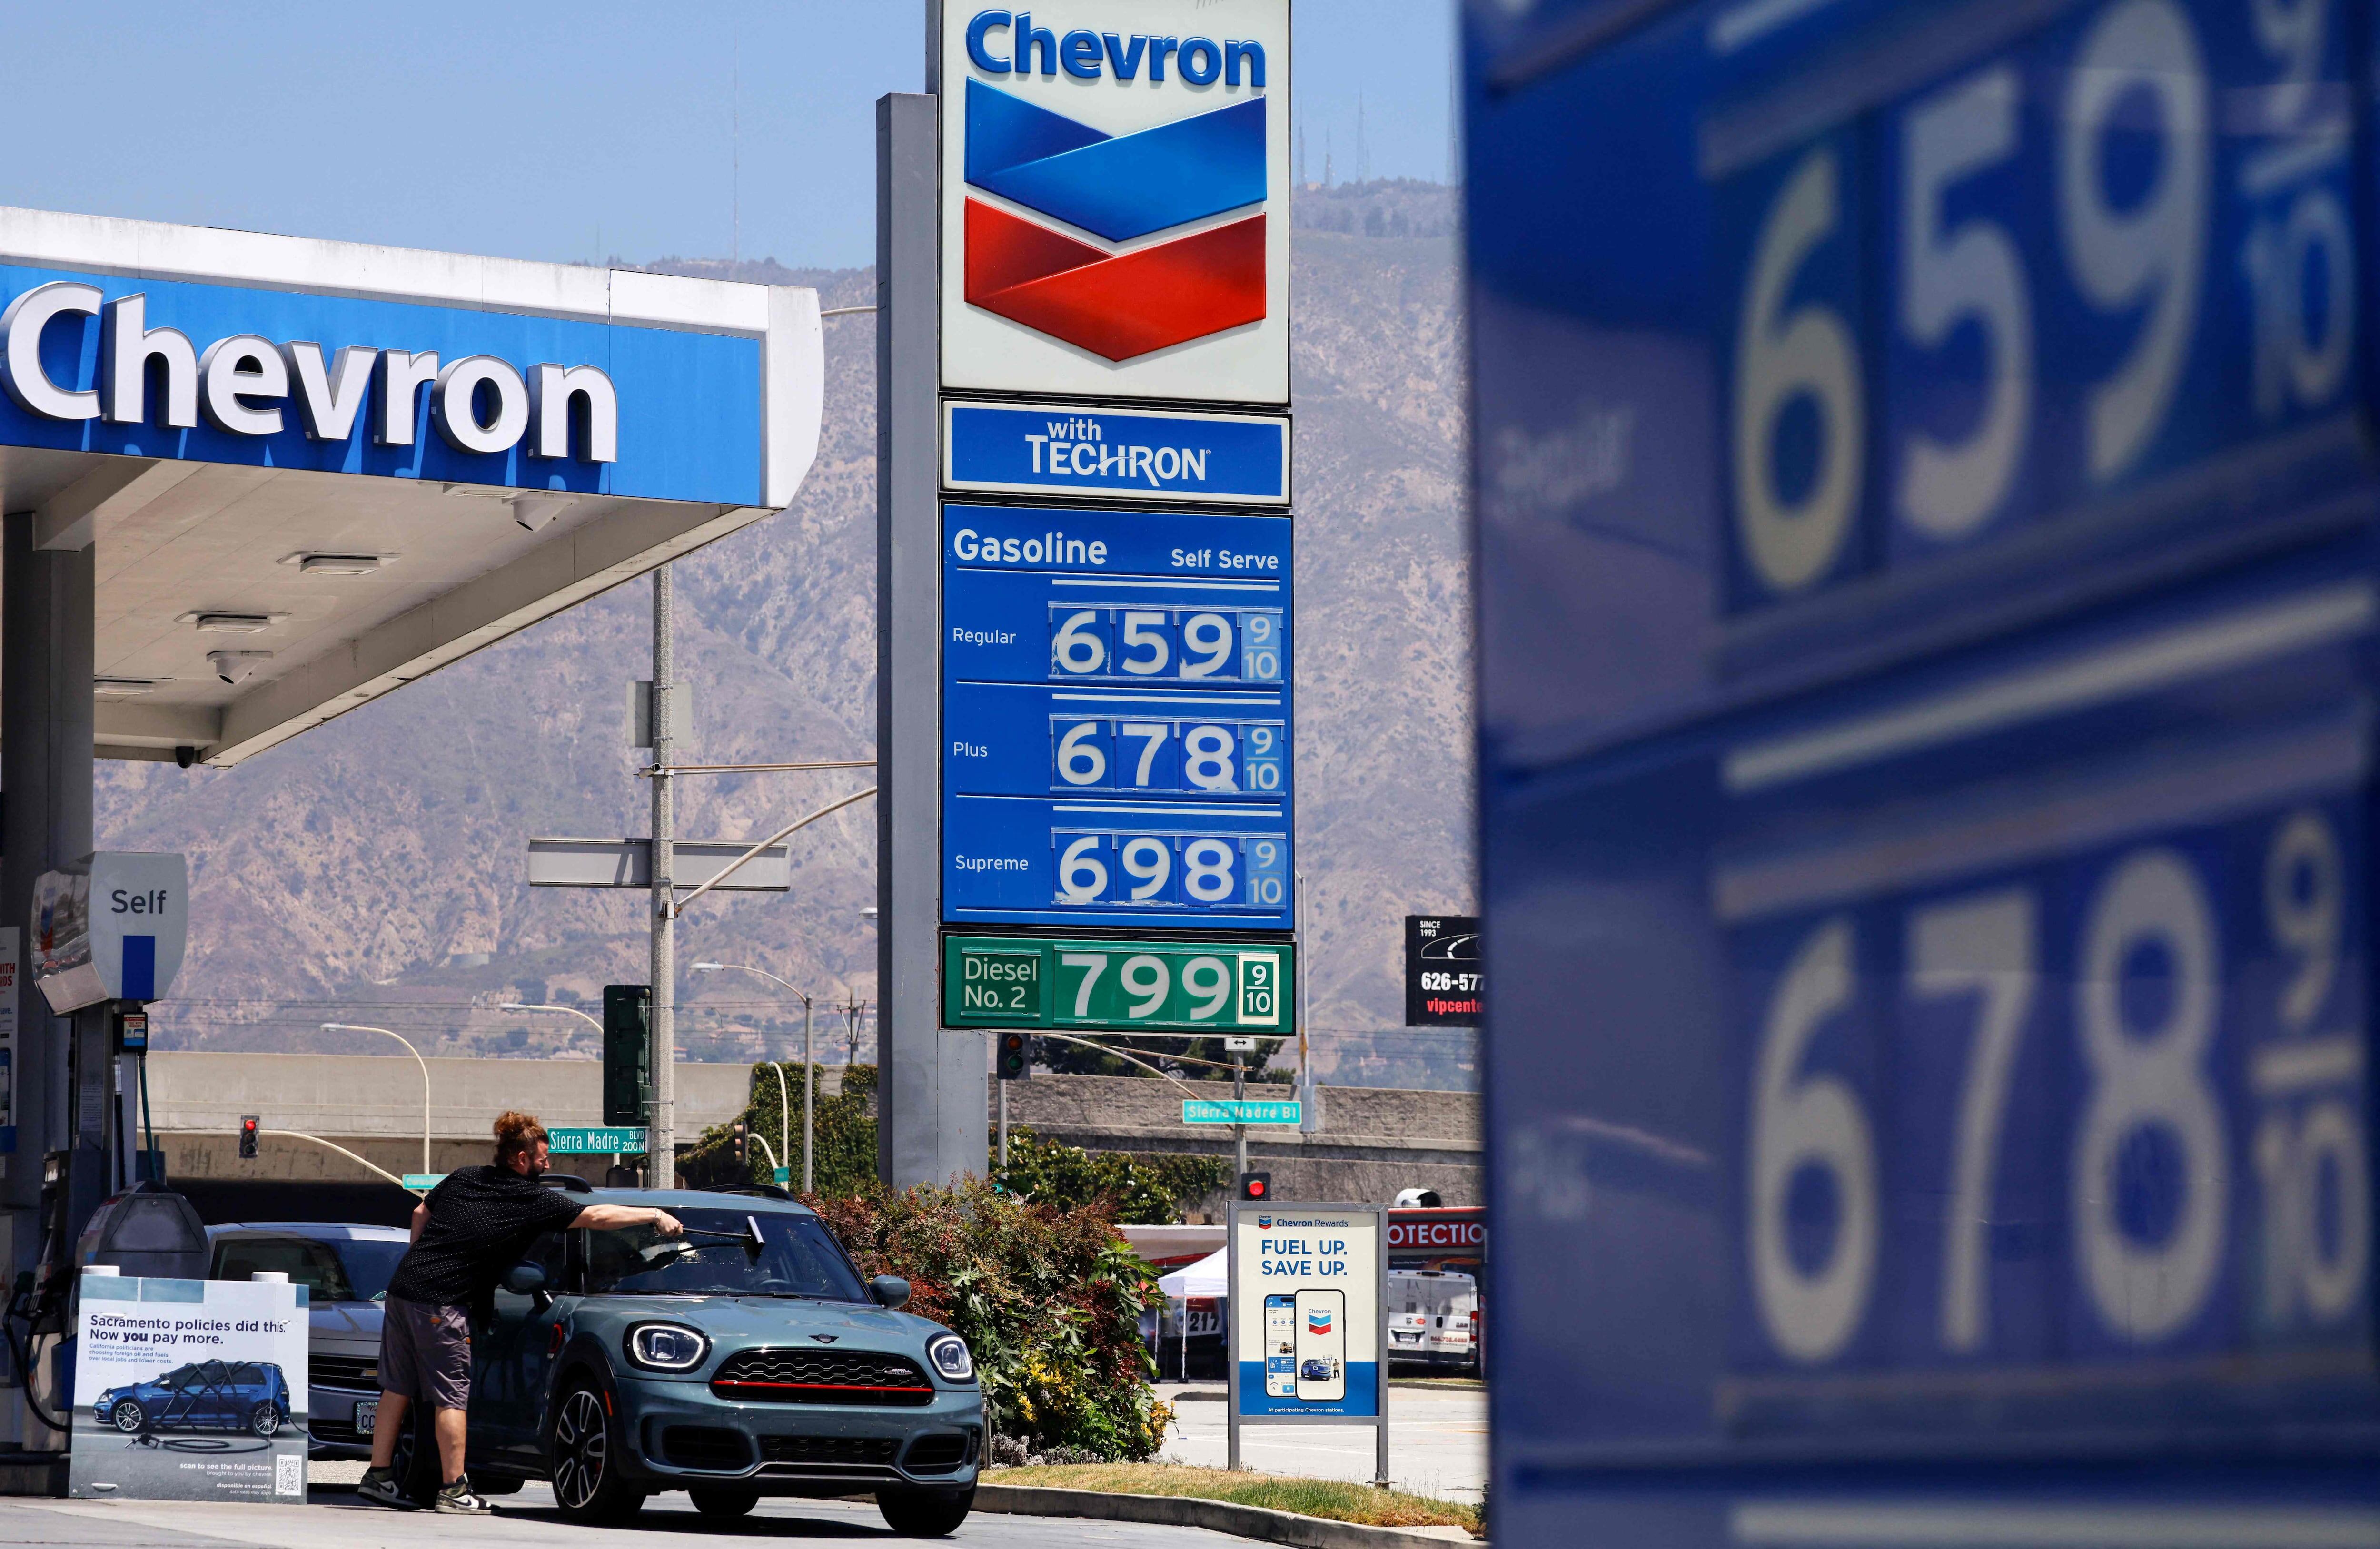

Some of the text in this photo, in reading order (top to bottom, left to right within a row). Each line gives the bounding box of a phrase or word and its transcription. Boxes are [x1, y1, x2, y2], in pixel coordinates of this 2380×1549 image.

[966, 10, 1266, 88] Chevron
[0, 281, 618, 463] Chevron
[1048, 417, 1101, 441] with
[954, 528, 1107, 565] Gasoline
[1171, 548, 1279, 570] Self Serve
[953, 627, 1017, 646] Regular
[1250, 616, 1270, 643] 9
[1244, 651, 1278, 679] 10
[953, 741, 988, 758] Plus
[1251, 727, 1272, 754] 9
[1246, 762, 1279, 790] 10
[955, 855, 1029, 871] Supreme
[1255, 841, 1276, 868] 9
[1250, 876, 1282, 903] 10
[111, 889, 167, 914] Self
[1420, 920, 1440, 928] SINCE
[965, 957, 1037, 981] Diesel
[1251, 965, 1267, 986] 9
[965, 985, 1026, 1008] No. 2
[1247, 992, 1271, 1013] 10
[1188, 1106, 1230, 1118] Sierra
[1235, 1106, 1277, 1119] Madre
[550, 1130, 645, 1150] Sierra Madre BLVD
[1277, 1219, 1312, 1227] Chevron
[1262, 1239, 1348, 1255] FUEL UP.
[1261, 1260, 1347, 1276] SAVE UP.
[90, 1315, 286, 1333] Sacramento policies did this.
[90, 1329, 224, 1344] Now you pay more.
